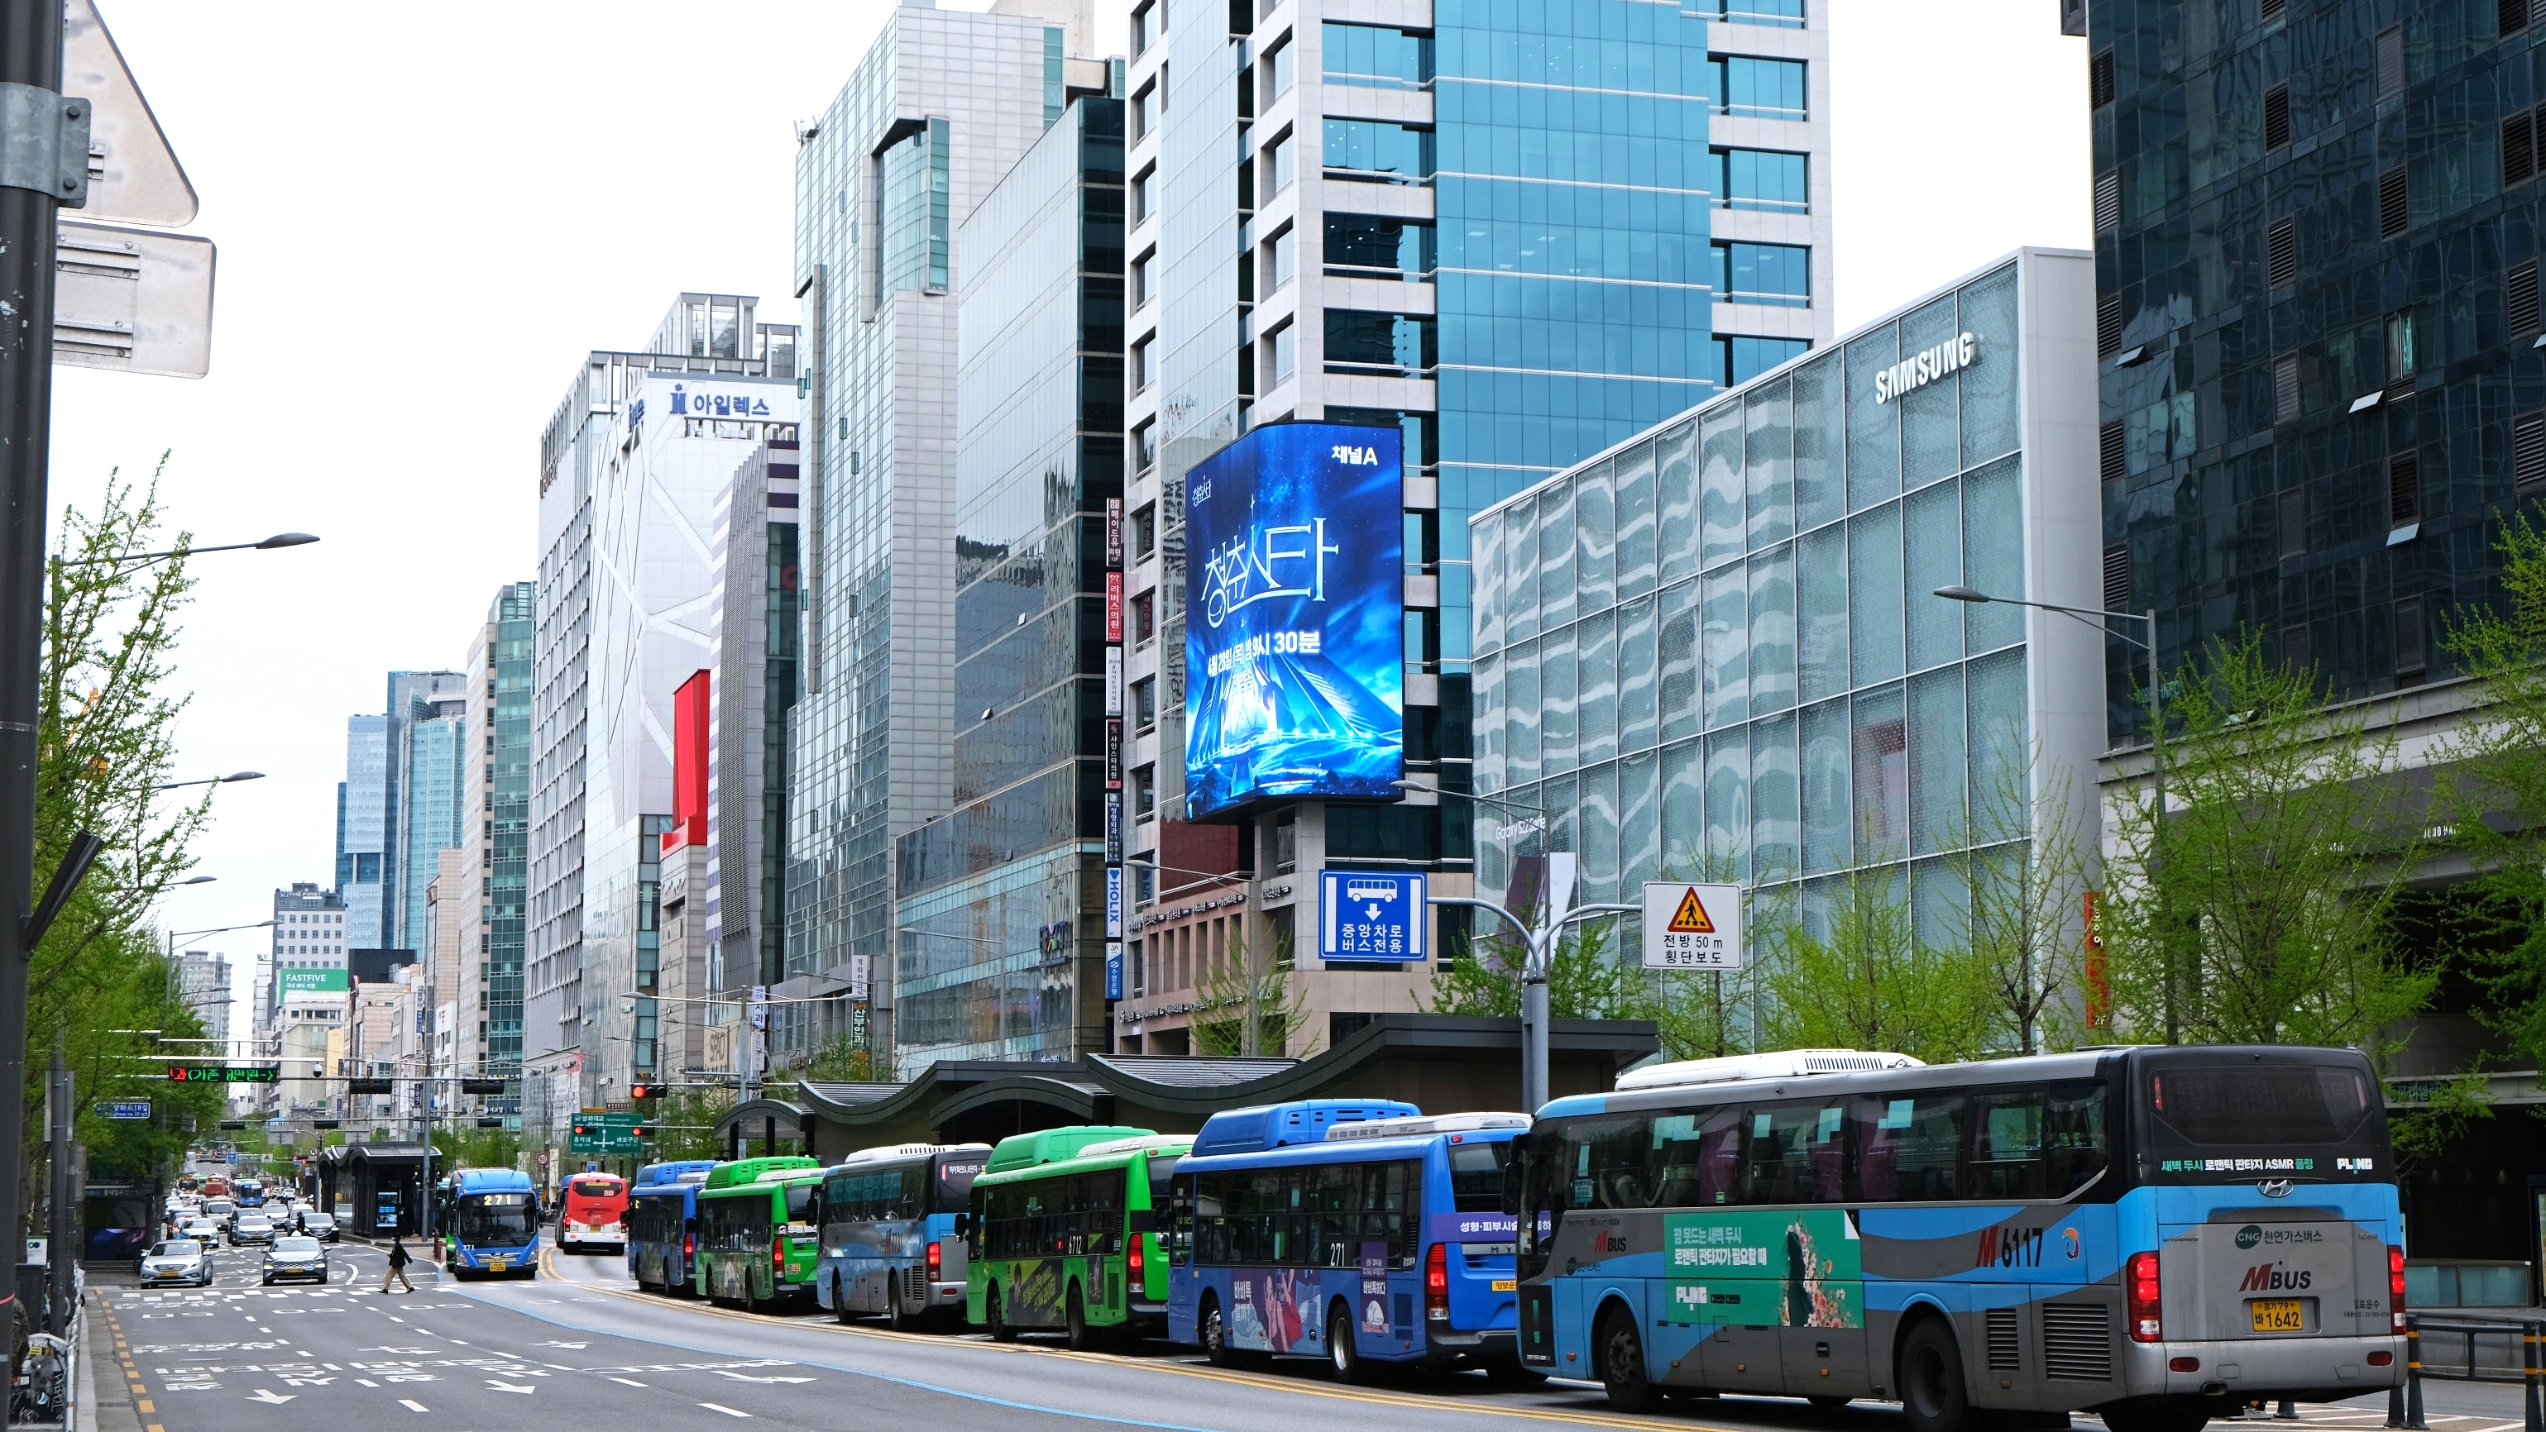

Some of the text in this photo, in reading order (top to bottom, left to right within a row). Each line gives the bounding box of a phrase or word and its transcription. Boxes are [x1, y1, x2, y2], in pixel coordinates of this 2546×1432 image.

[1875, 331, 1976, 405] SAMSUNG
[694, 394, 769, 416] 아일렉스
[1332, 445, 1378, 466] 채널A
[1273, 631, 1321, 654] 30분
[1496, 812, 1546, 840] Galaxy S22 Serie
[1109, 881, 1119, 922] HOLIX
[1342, 923, 1403, 938] 중앙차로
[1342, 938, 1403, 954] 버스전용
[1663, 934, 1690, 948] 전방
[1696, 936, 1709, 948] 50
[1665, 950, 1722, 964] 횡단보도
[286, 974, 326, 982] FASTFIVE
[854, 1008, 866, 1047] 산부인과
[538, 1155, 547, 1163] 50
[2161, 1158, 2313, 1171] 새벽 두시 로맨틱 판타지 ASMR 플링
[484, 1195, 511, 1206] 271
[1673, 1227, 1742, 1244] 잠 못드는 새벽 두시
[2237, 1230, 2322, 1244] CNG 천연가스버스
[1069, 1235, 1082, 1255] 6712
[1330, 1243, 1345, 1266] 271
[1674, 1248, 1768, 1265] 로맨틱 판타지가 필요할 때
